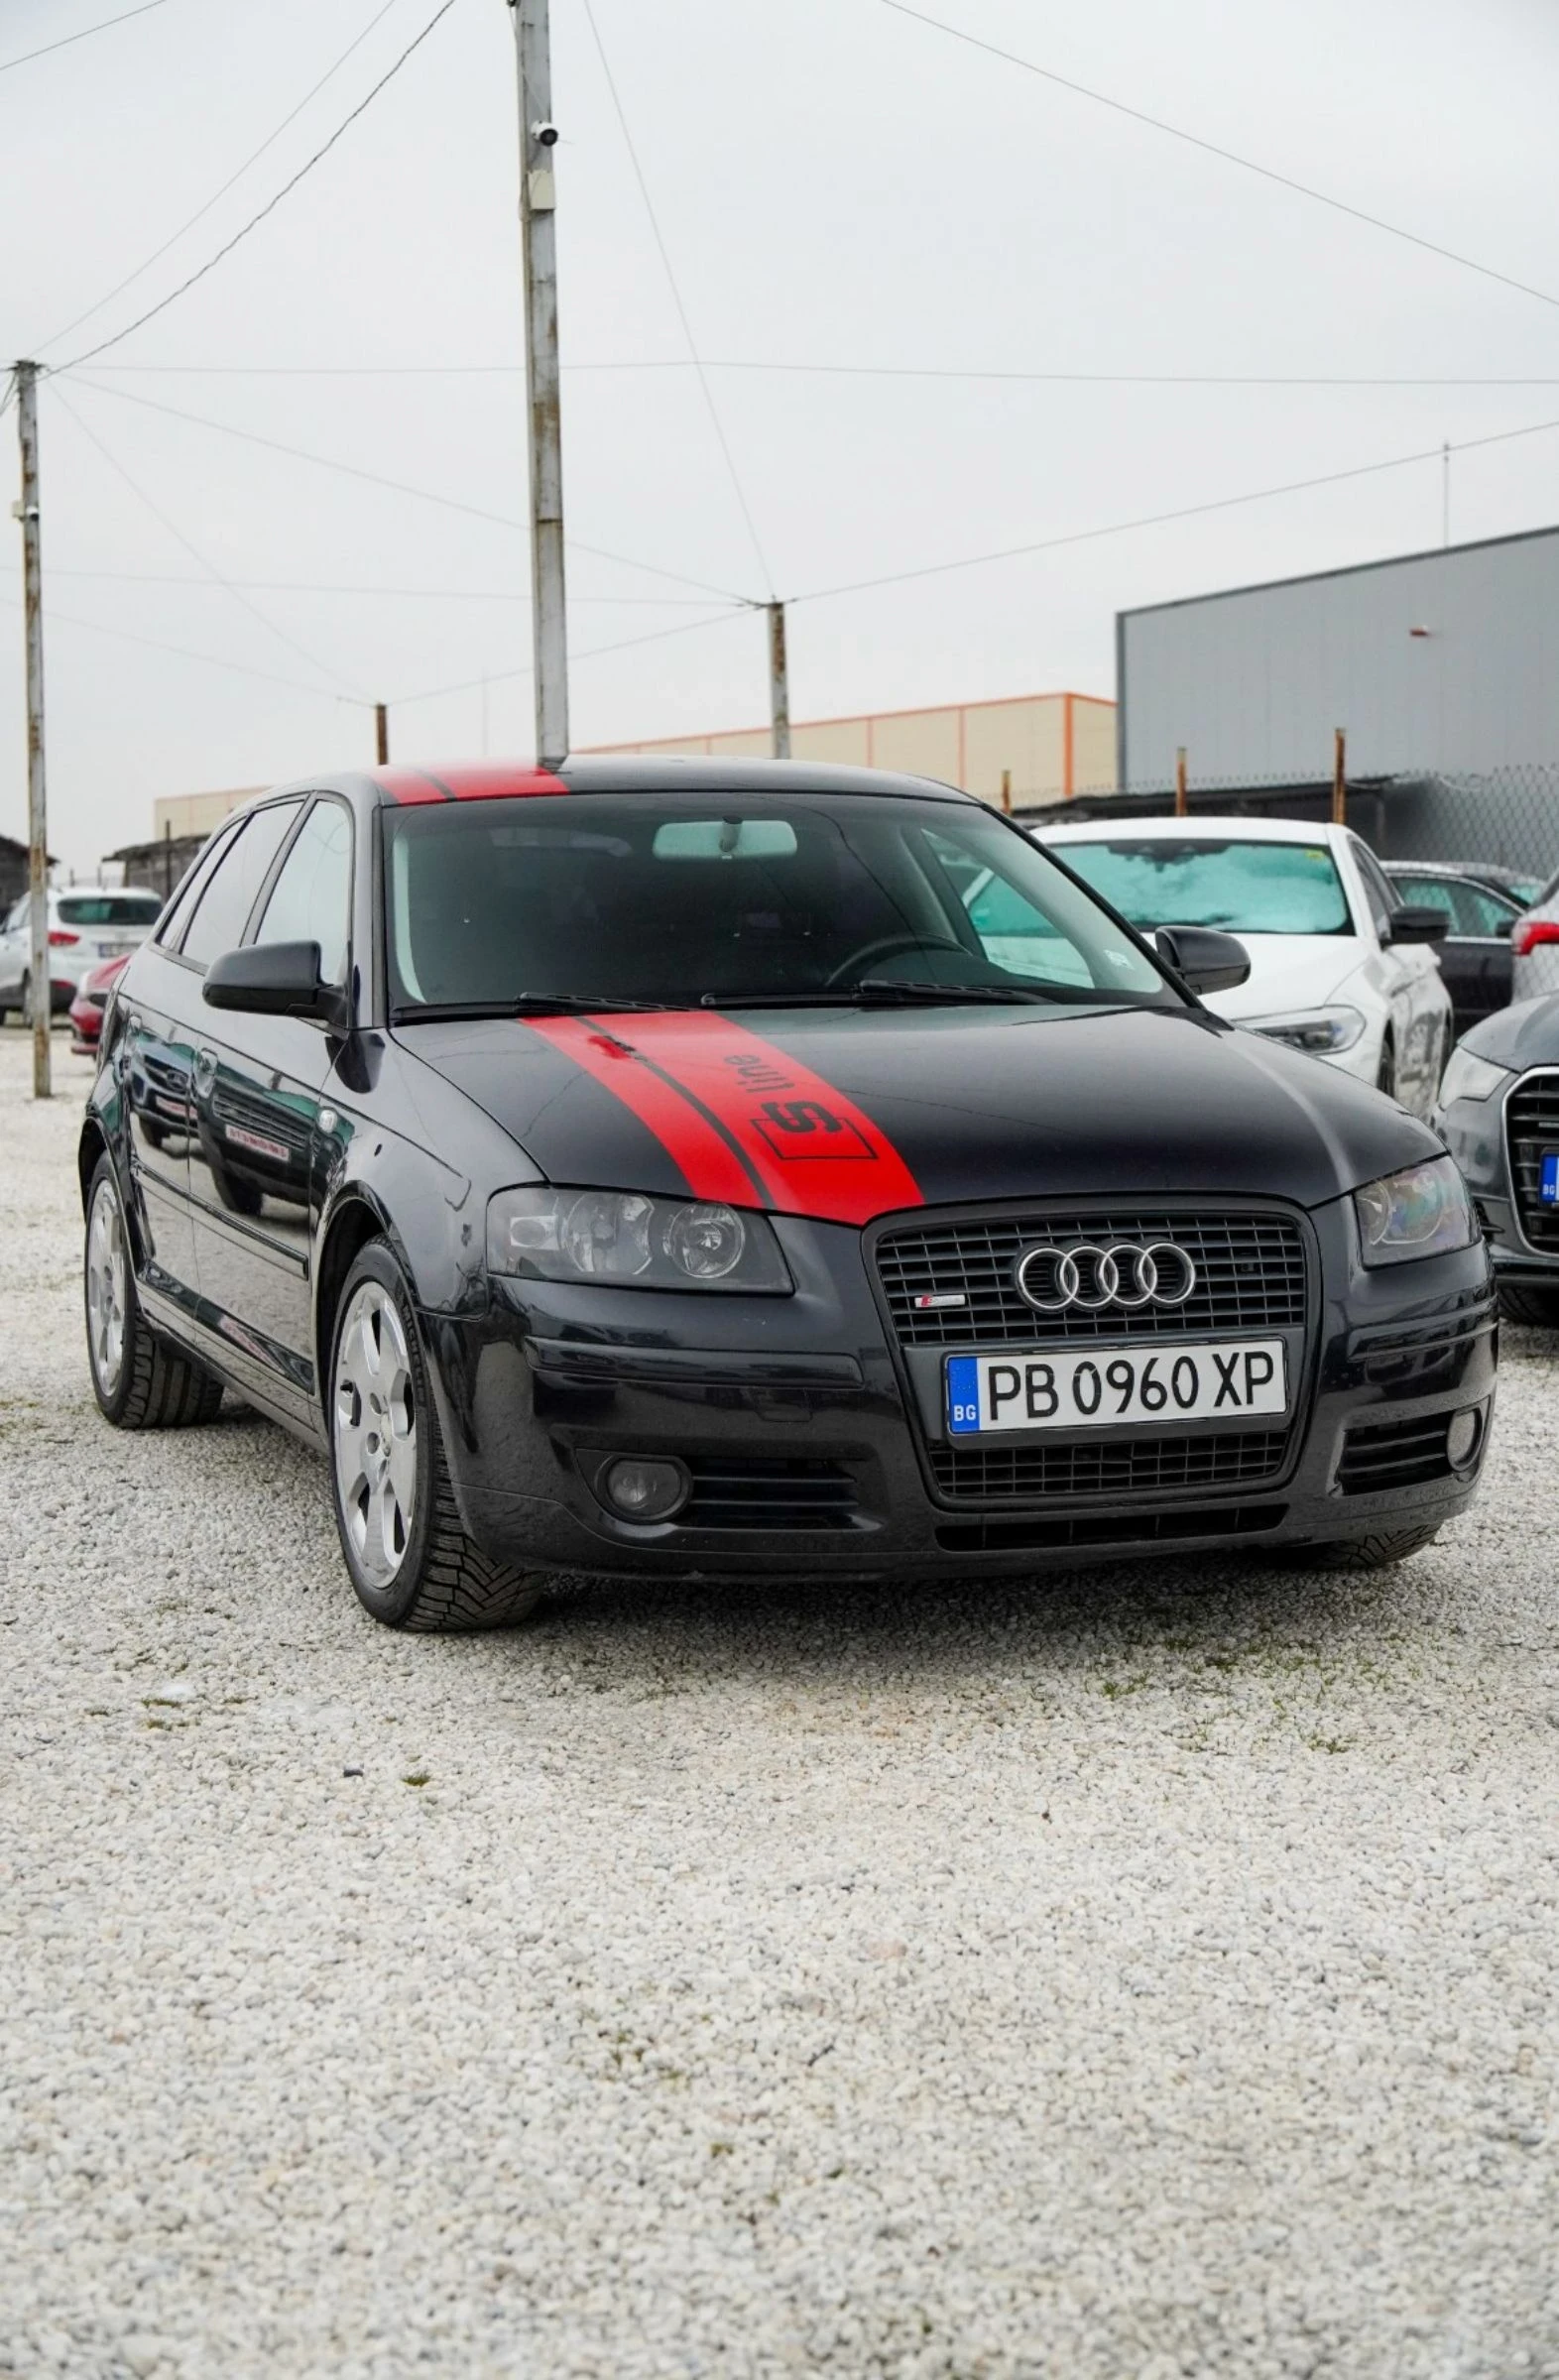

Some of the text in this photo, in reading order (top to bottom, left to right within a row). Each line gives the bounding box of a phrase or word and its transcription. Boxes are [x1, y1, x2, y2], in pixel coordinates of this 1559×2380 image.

[725, 1055, 842, 1132] S line
[954, 1404, 977, 1422] BG
[989, 1351, 1273, 1420] PB 0960 XP
